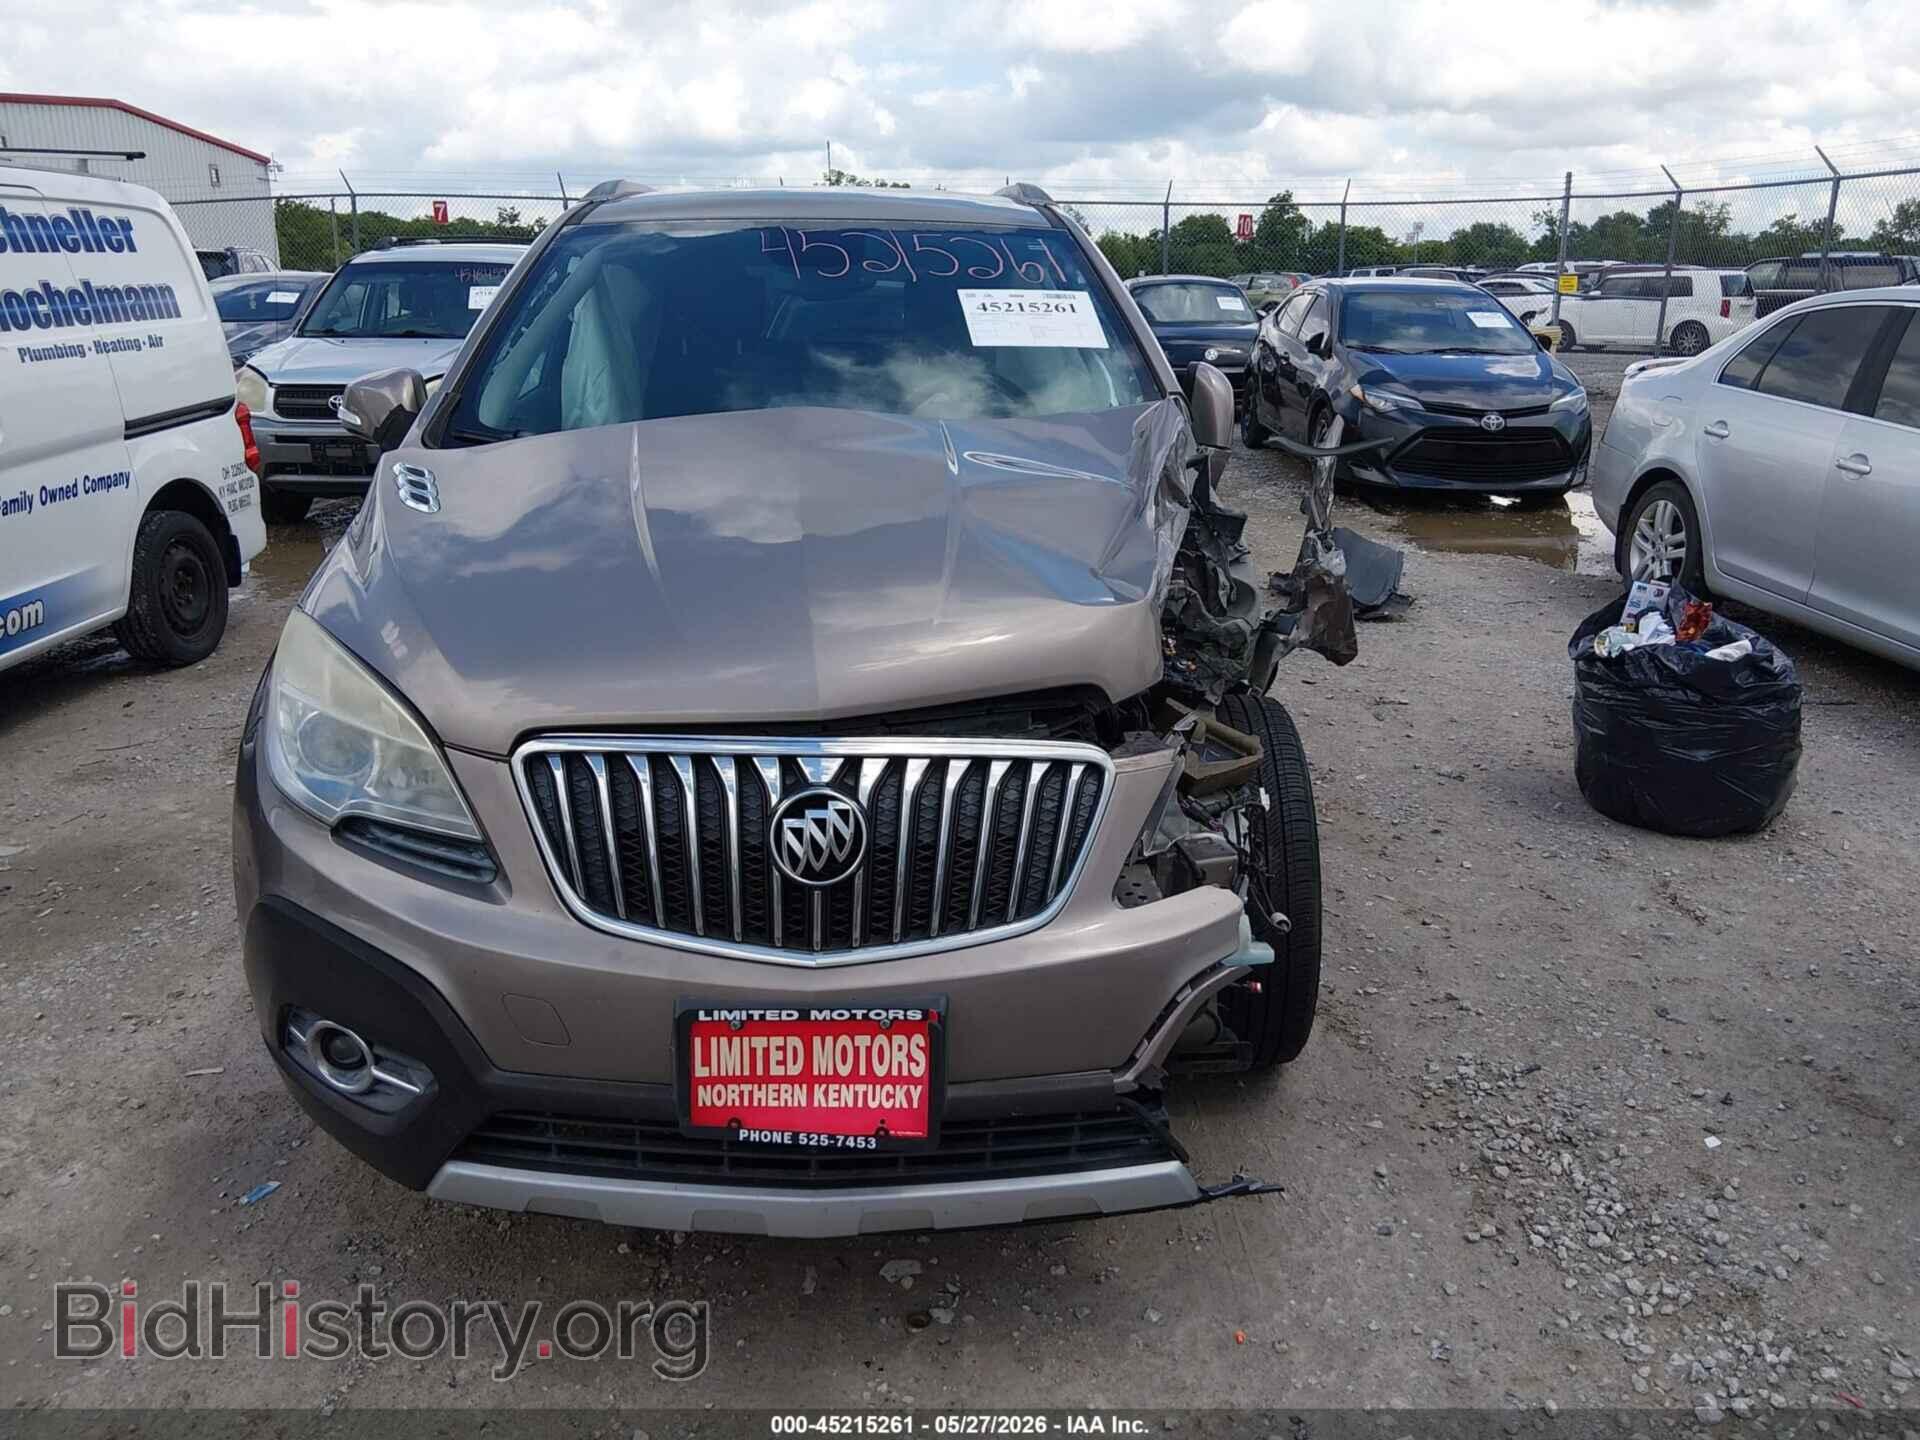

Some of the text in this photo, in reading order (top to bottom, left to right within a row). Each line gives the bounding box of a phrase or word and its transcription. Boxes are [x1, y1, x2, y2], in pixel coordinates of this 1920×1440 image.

[434, 203, 446, 220] 7
[1240, 217, 1251, 234] 10
[976, 301, 1079, 314] 45215261
[17, 334, 164, 364] Plumbing Heating Air
[39, 478, 79, 506] Owned
[83, 470, 131, 494] Company
[698, 1010, 923, 1021] LIMITED MOTORS
[694, 1034, 926, 1077] LIMITED MOTORS
[698, 1083, 922, 1109] NORTHERN KENTUCKY
[739, 1129, 877, 1149] PHONE 525-7453
